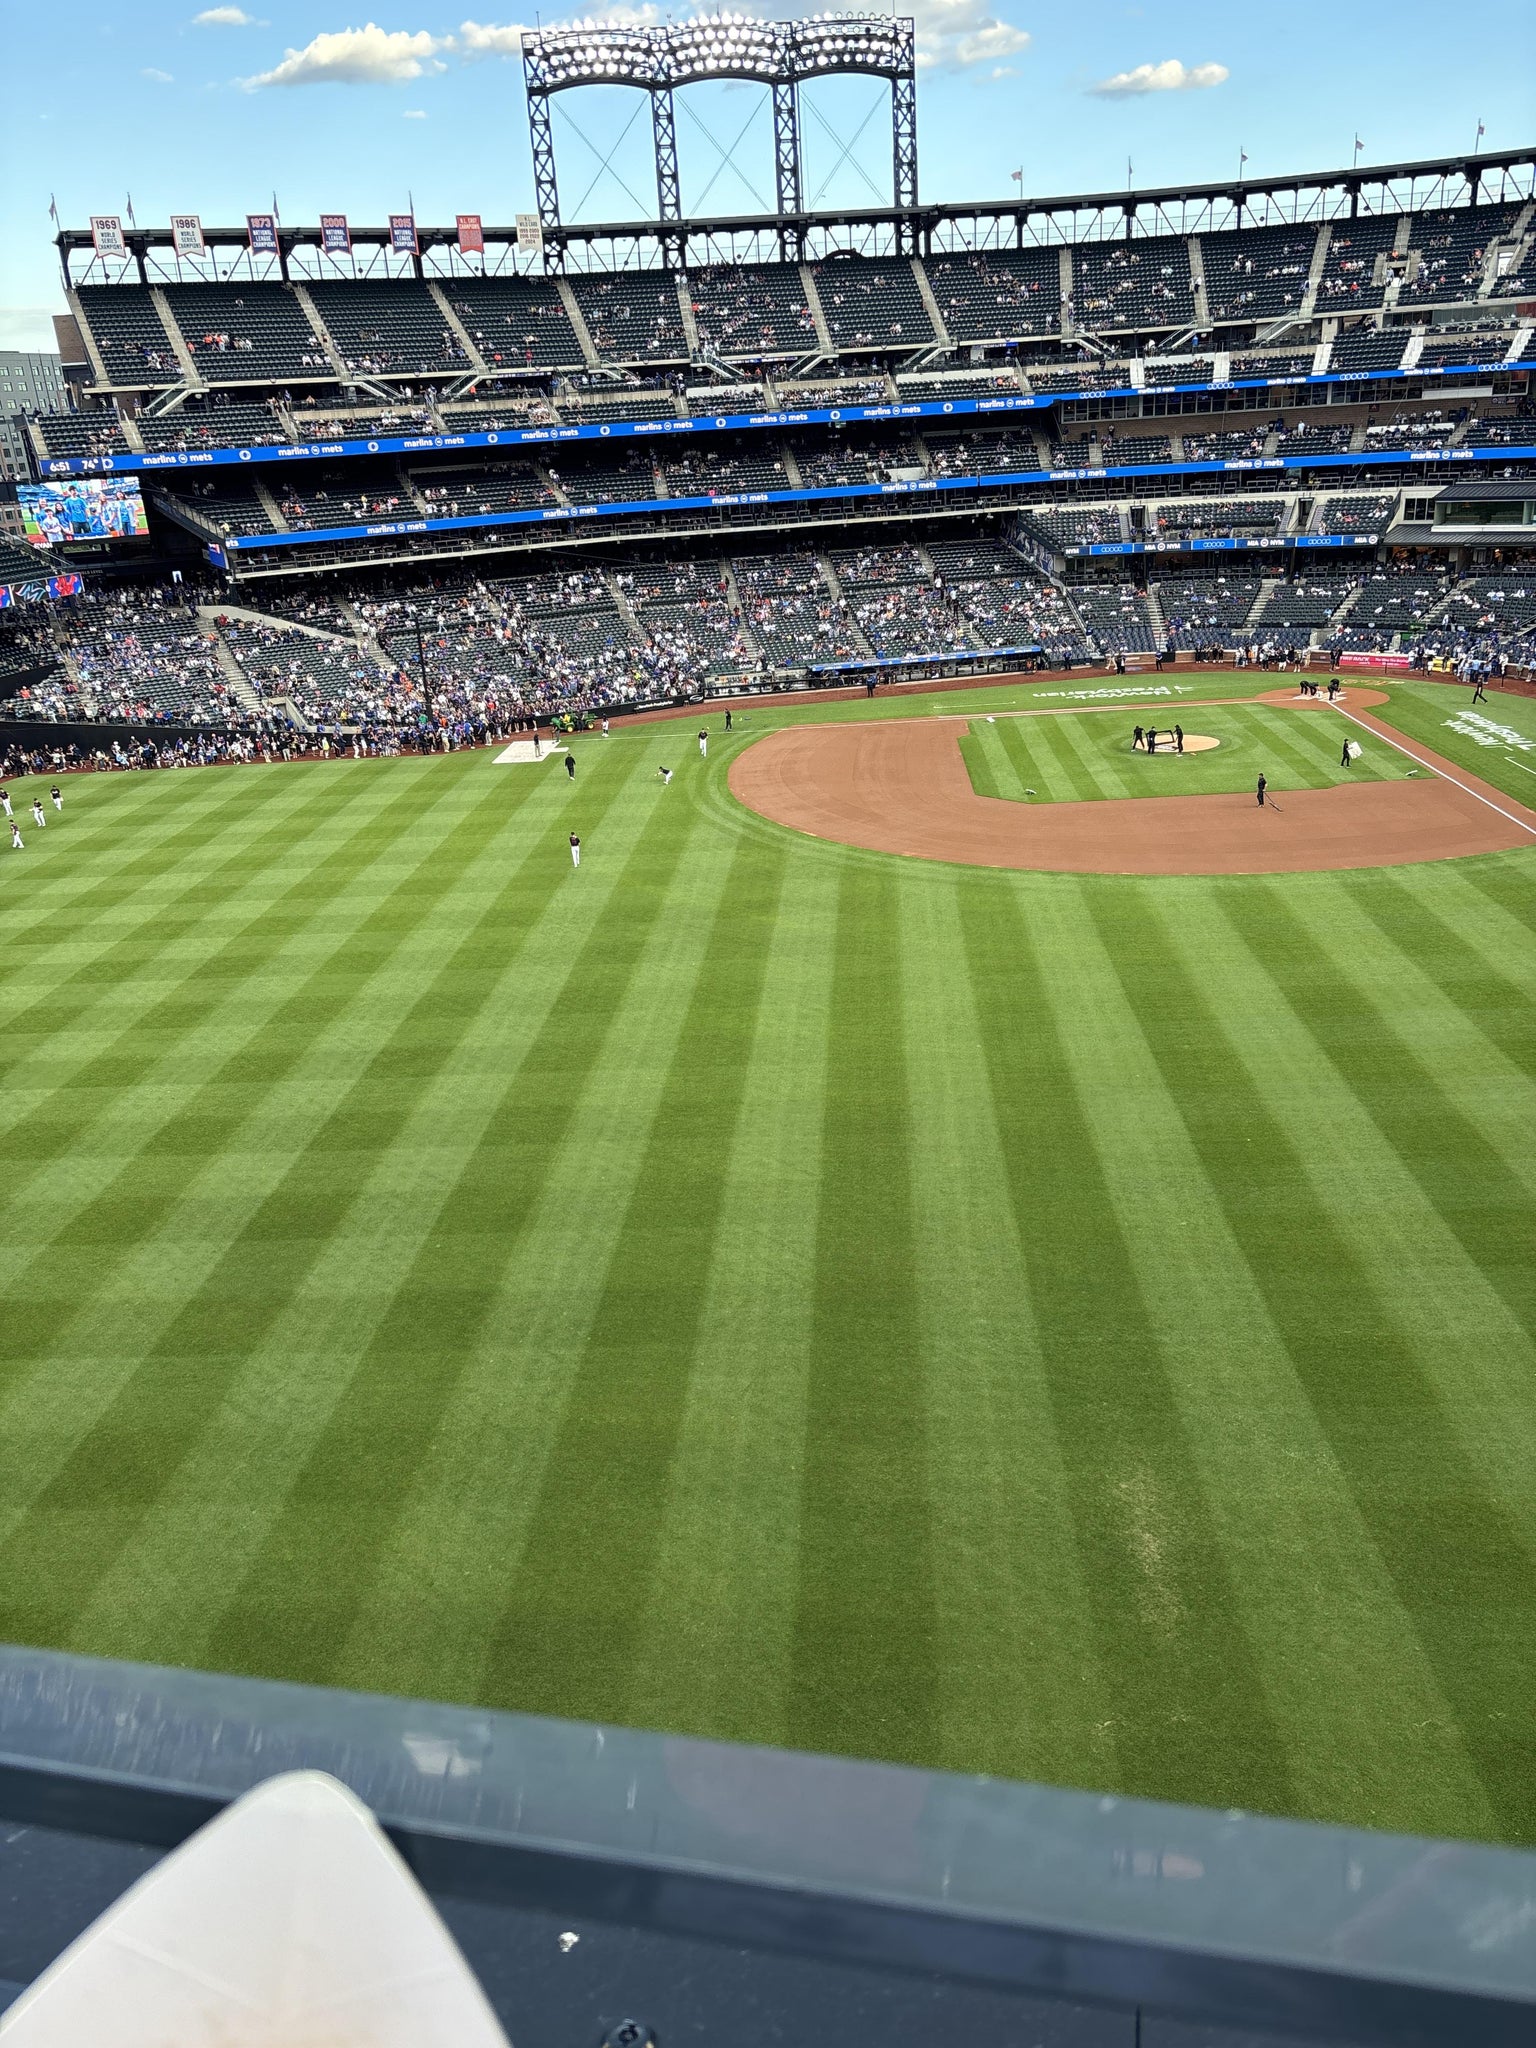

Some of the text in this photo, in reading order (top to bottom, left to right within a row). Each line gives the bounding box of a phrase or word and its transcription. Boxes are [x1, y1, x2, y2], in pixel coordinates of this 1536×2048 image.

[96, 220, 116, 229] 1969
[176, 219, 196, 228] 1986
[251, 218, 271, 228] 1973
[323, 218, 345, 227] 2000
[393, 218, 411, 228] 2015
[976, 400, 1005, 408] marlins
[750, 415, 777, 423] marlins
[634, 423, 662, 431] marlins
[522, 431, 549, 439] marlins
[404, 439, 433, 447] marlins
[278, 447, 309, 455] marlins
[1411, 450, 1440, 459] marlins
[1452, 449, 1473, 458] mets
[143, 455, 176, 464] marlins
[1225, 459, 1252, 468] marlins
[50, 462, 70, 471] 6:51
[1050, 470, 1076, 478] marlins
[882, 481, 907, 491] marlins
[712, 494, 738, 503] marlins
[543, 508, 569, 517] marlins
[367, 524, 395, 534] marlins
